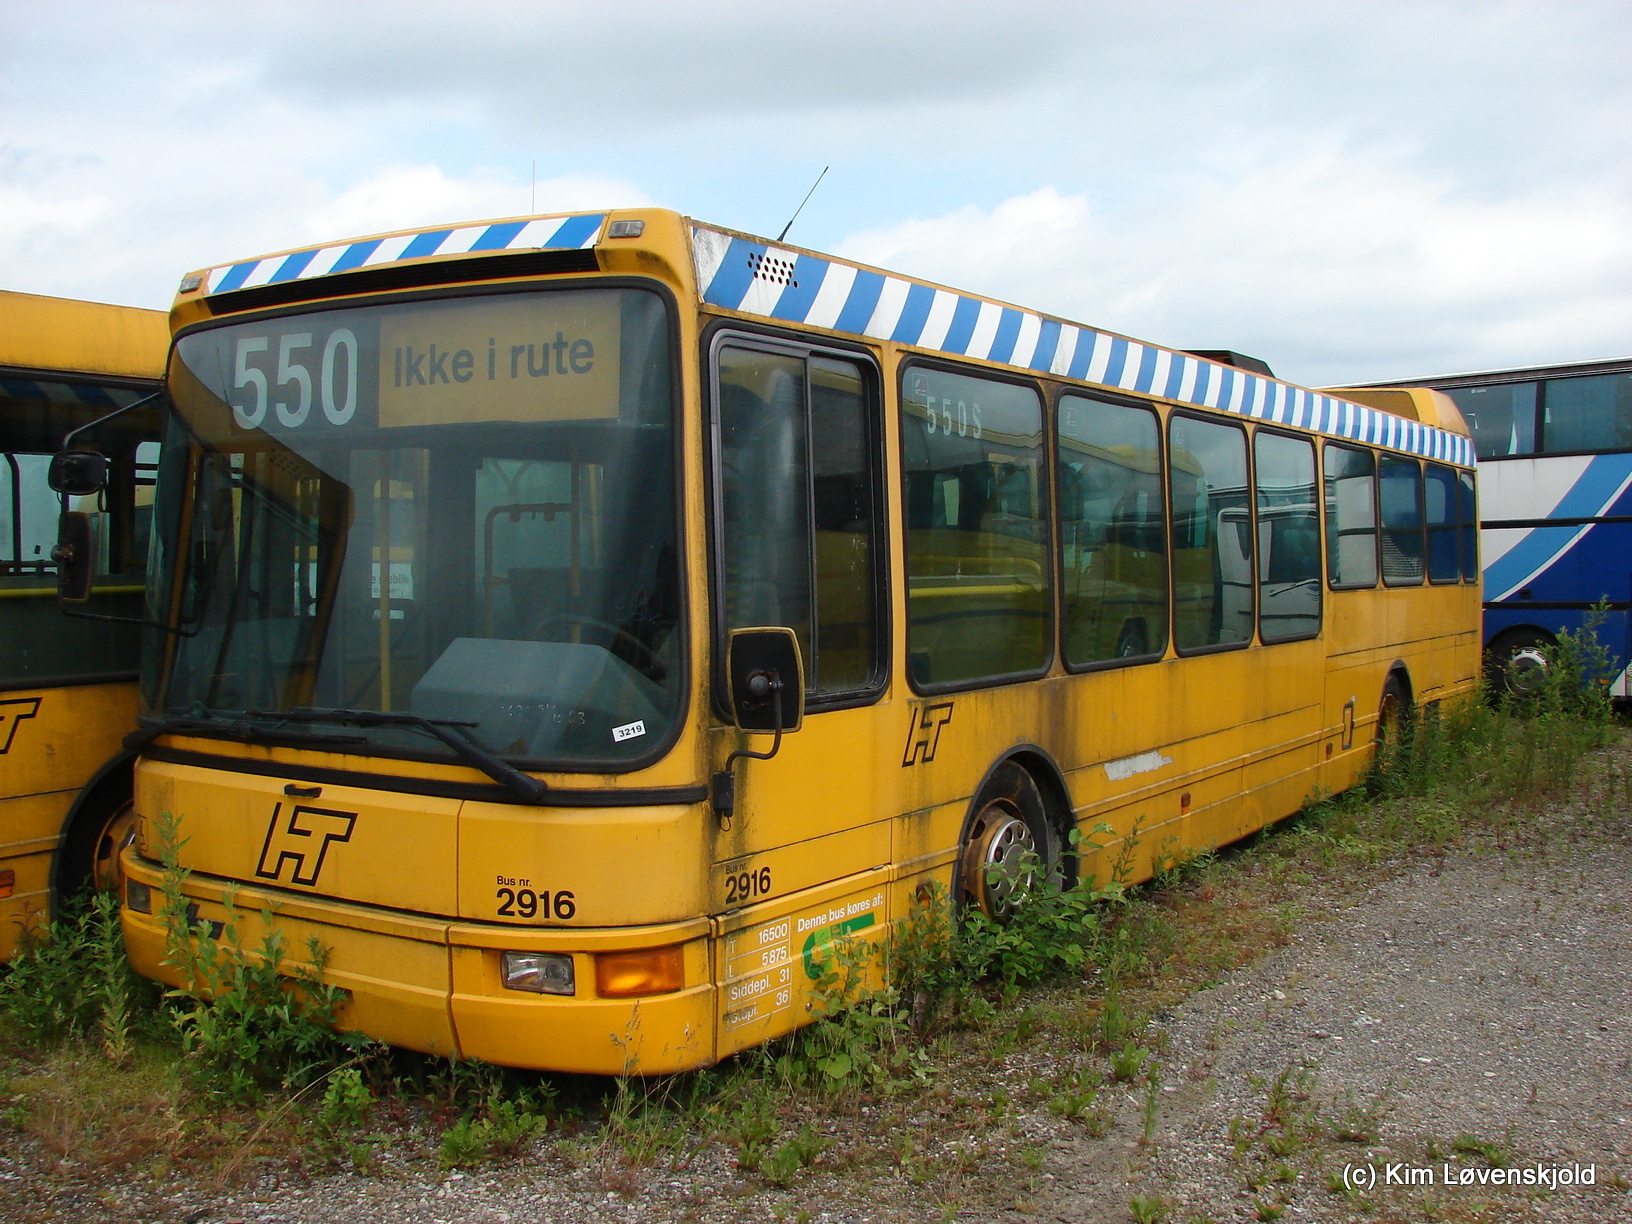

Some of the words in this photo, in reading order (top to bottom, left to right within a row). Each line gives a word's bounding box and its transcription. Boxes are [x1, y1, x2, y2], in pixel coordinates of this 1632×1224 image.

[394, 344, 475, 388] Ikke
[488, 337, 496, 381] i
[510, 331, 595, 380] rute
[232, 328, 358, 430] 550
[926, 395, 982, 439] 550S
[618, 724, 643, 738] 3219
[496, 875, 516, 886] Bus
[519, 878, 533, 887] nr.
[725, 864, 739, 875] Bus
[725, 866, 771, 904] 2916
[496, 887, 576, 920] 2916
[797, 914, 827, 932] Denne
[829, 907, 846, 922] bus
[847, 898, 871, 916] køres
[872, 892, 884, 907] af:
[729, 939, 737, 954] T
[758, 922, 789, 945] 16500
[729, 964, 736, 978] L
[761, 945, 788, 967] 5875
[731, 974, 772, 1001] Siddepl.
[779, 966, 790, 983] 31
[775, 989, 789, 1007] 36
